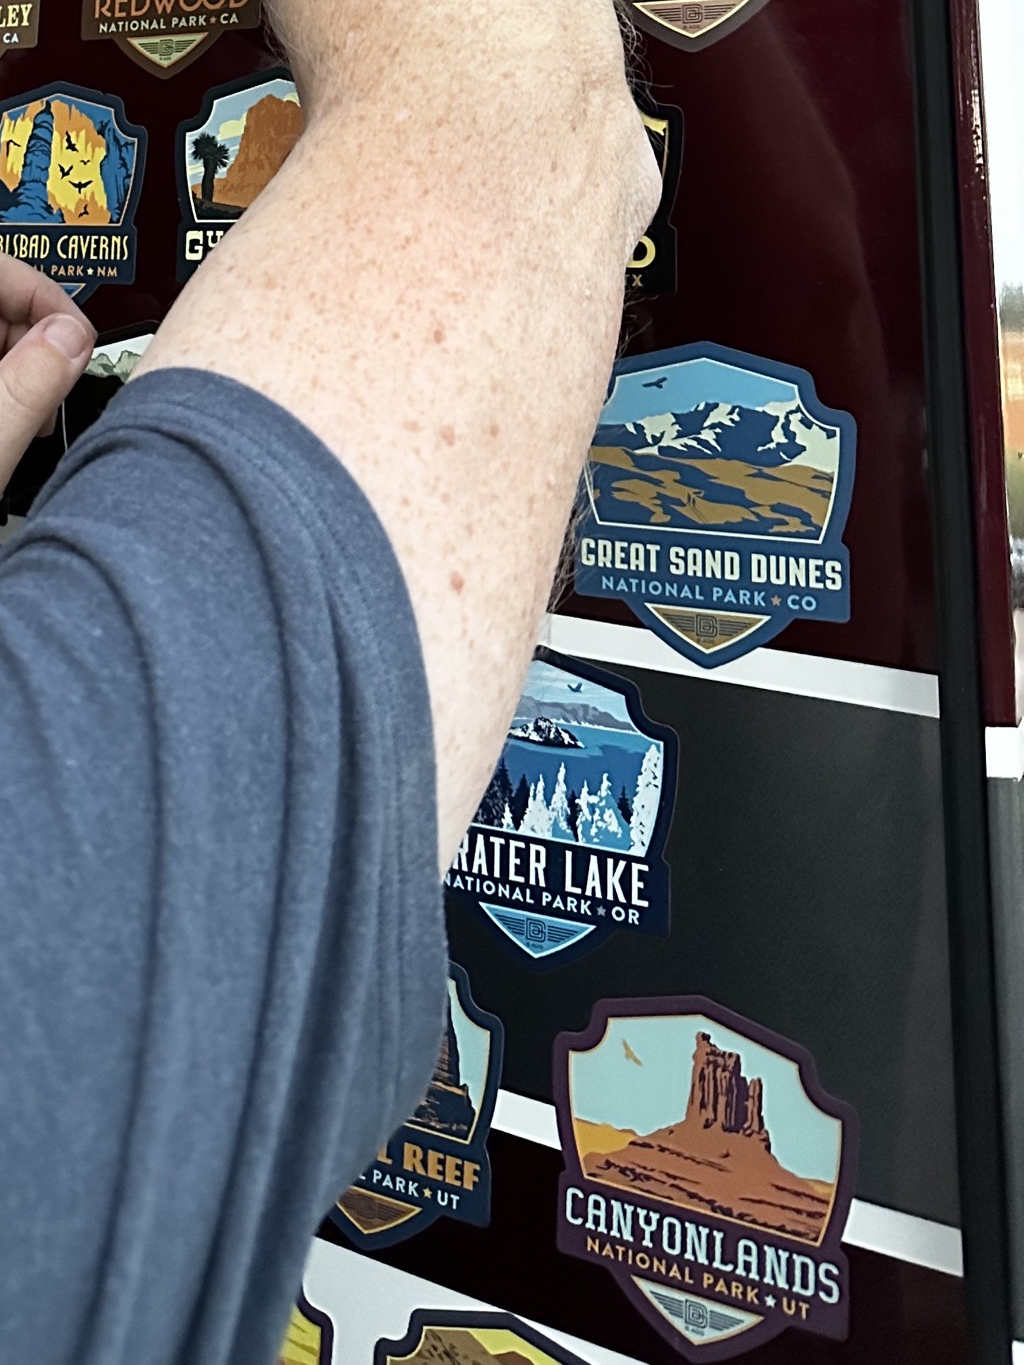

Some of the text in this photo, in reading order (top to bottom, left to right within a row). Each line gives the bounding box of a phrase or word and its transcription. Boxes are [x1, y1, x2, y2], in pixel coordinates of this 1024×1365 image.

[3, 33, 19, 44] CA
[99, 13, 239, 33] NATIONAL PARK CA
[56, 235, 129, 261] CAVERNS
[51, 265, 85, 277] PARK
[97, 265, 118, 278] NM
[581, 538, 842, 590] GREAT SAND DUNES
[601, 575, 817, 612] NATIONAL PARK CO
[453, 833, 650, 908] RATER LAKE
[542, 891, 592, 916] PARK
[612, 906, 640, 925] OR
[403, 1142, 481, 1191] REEF
[373, 1169, 460, 1210] PARK UT
[565, 1186, 841, 1304] CANYONLANDS
[586, 1237, 810, 1321] NATIONAL PARK UT
